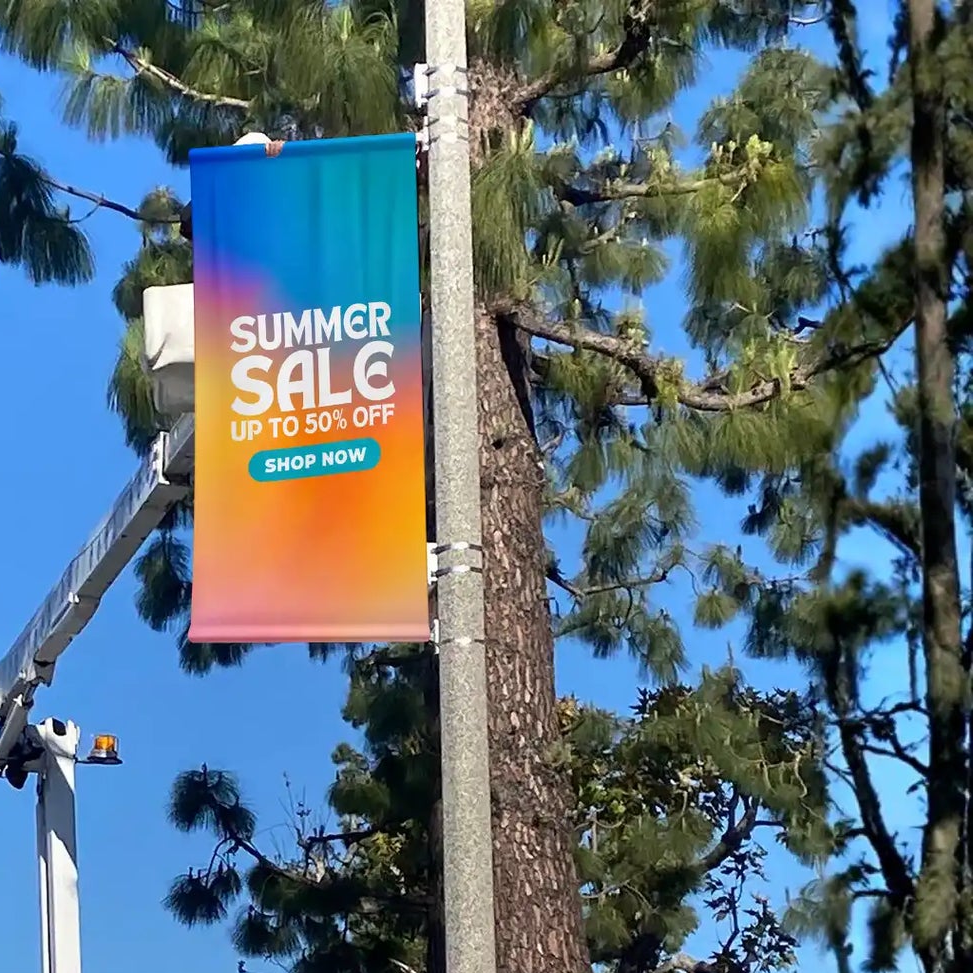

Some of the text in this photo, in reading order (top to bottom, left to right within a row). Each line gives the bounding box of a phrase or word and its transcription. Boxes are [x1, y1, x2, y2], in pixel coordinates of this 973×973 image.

[229, 301, 392, 353] SUMMER
[230, 340, 396, 417] SALE
[230, 403, 396, 442] UP TO 50% OFF
[264, 446, 367, 473] SHOP NOW
